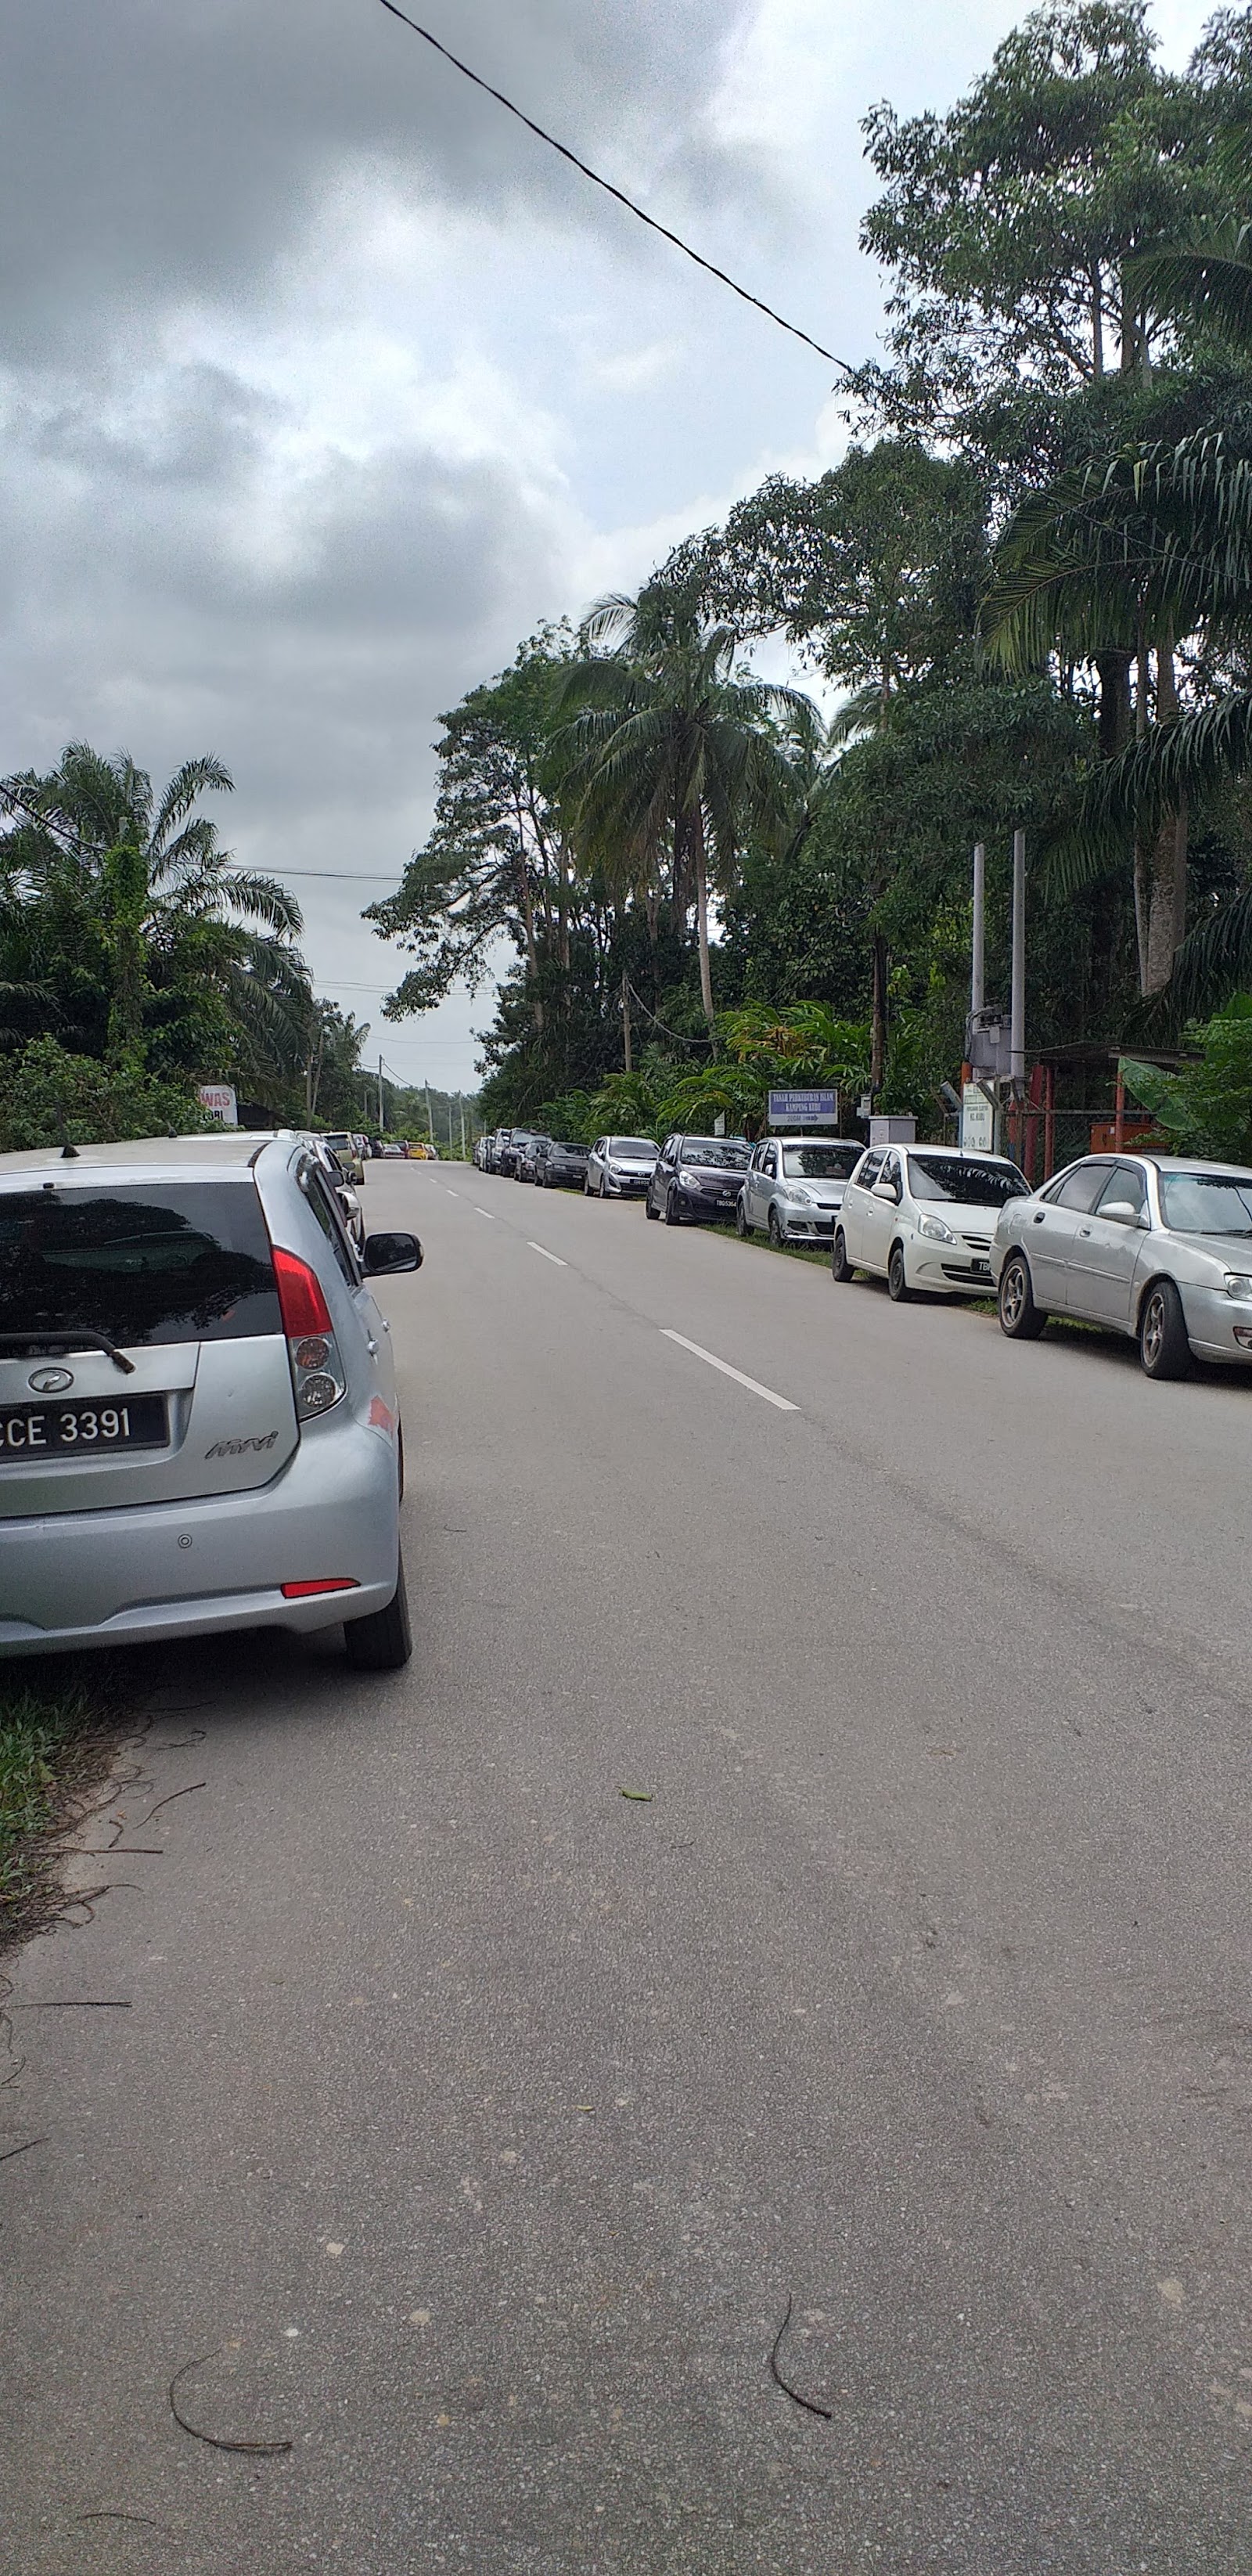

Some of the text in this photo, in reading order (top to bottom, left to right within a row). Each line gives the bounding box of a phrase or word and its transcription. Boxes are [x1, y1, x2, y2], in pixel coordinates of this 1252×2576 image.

[200, 1092, 230, 1106] WAS
[0, 1407, 131, 1448] CE 3391
